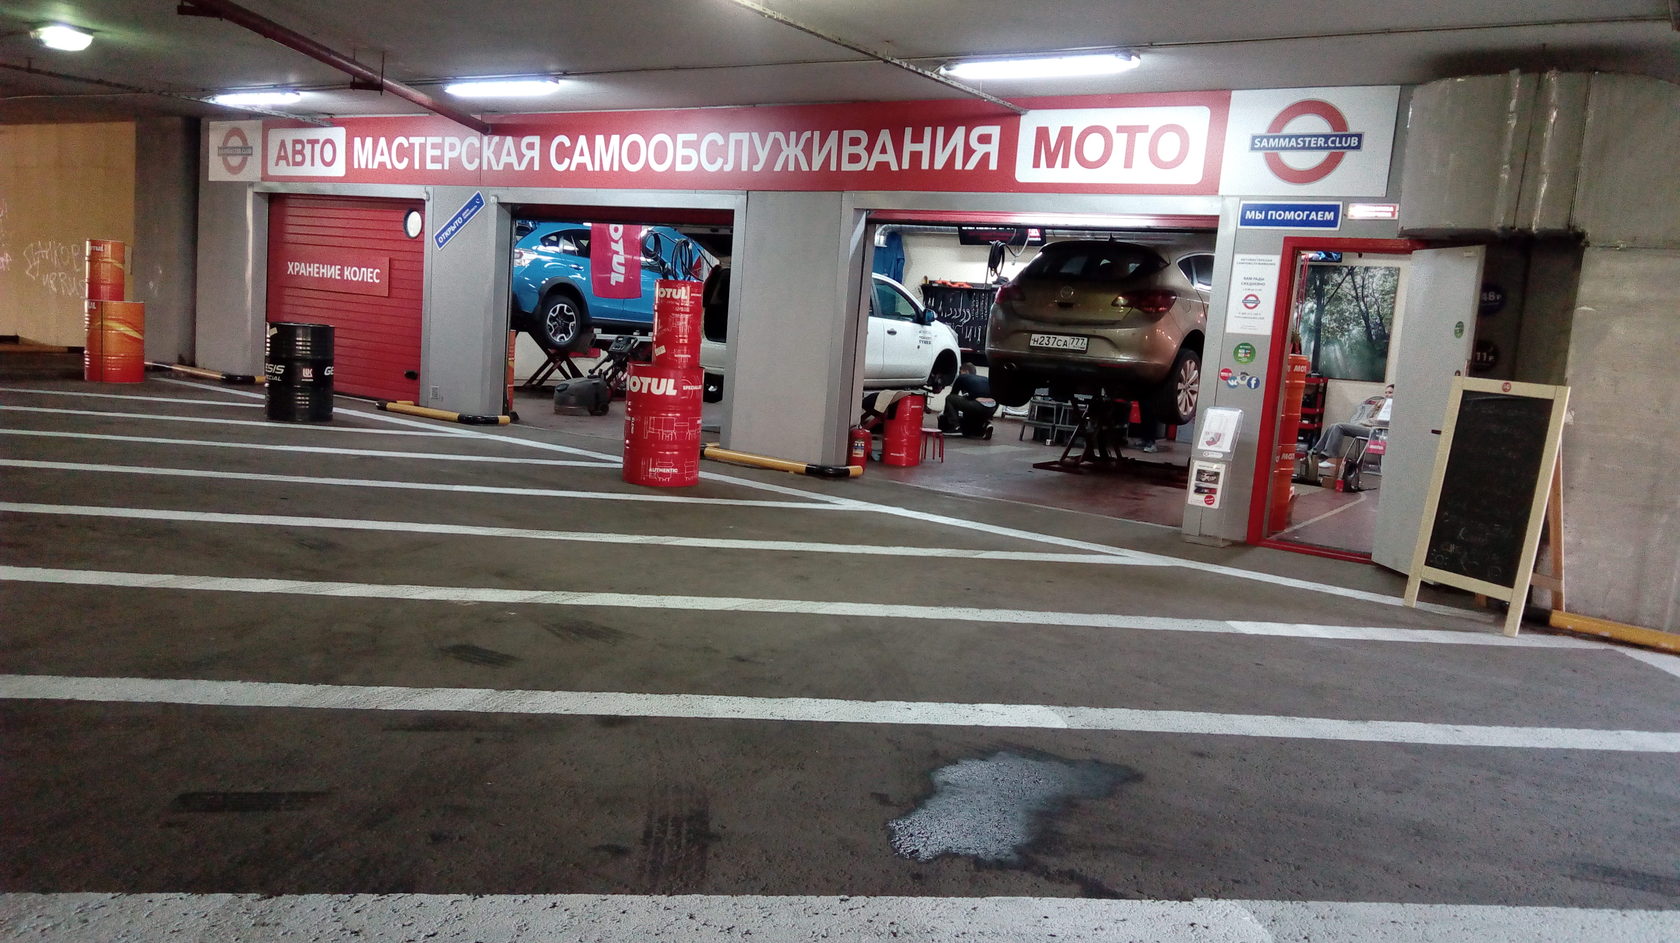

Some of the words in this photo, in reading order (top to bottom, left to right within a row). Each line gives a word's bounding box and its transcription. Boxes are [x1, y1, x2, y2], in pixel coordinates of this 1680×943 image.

[274, 138, 337, 167] АВТО
[353, 135, 541, 171] МАСТЕРСКАЯ
[549, 125, 1001, 173] САМООБСЛУЖИВАНИЯ
[1032, 123, 1190, 170] МОТО
[1253, 136, 1359, 149] SAMMASTER.CLUB
[1245, 210, 1265, 220] МЫ
[1268, 210, 1335, 221] ПОМОГАЕМ
[438, 216, 463, 243] ОТКРЫТО
[287, 261, 341, 280] ХРАНЕНИЕ
[344, 266, 381, 283] КОЛЕС
